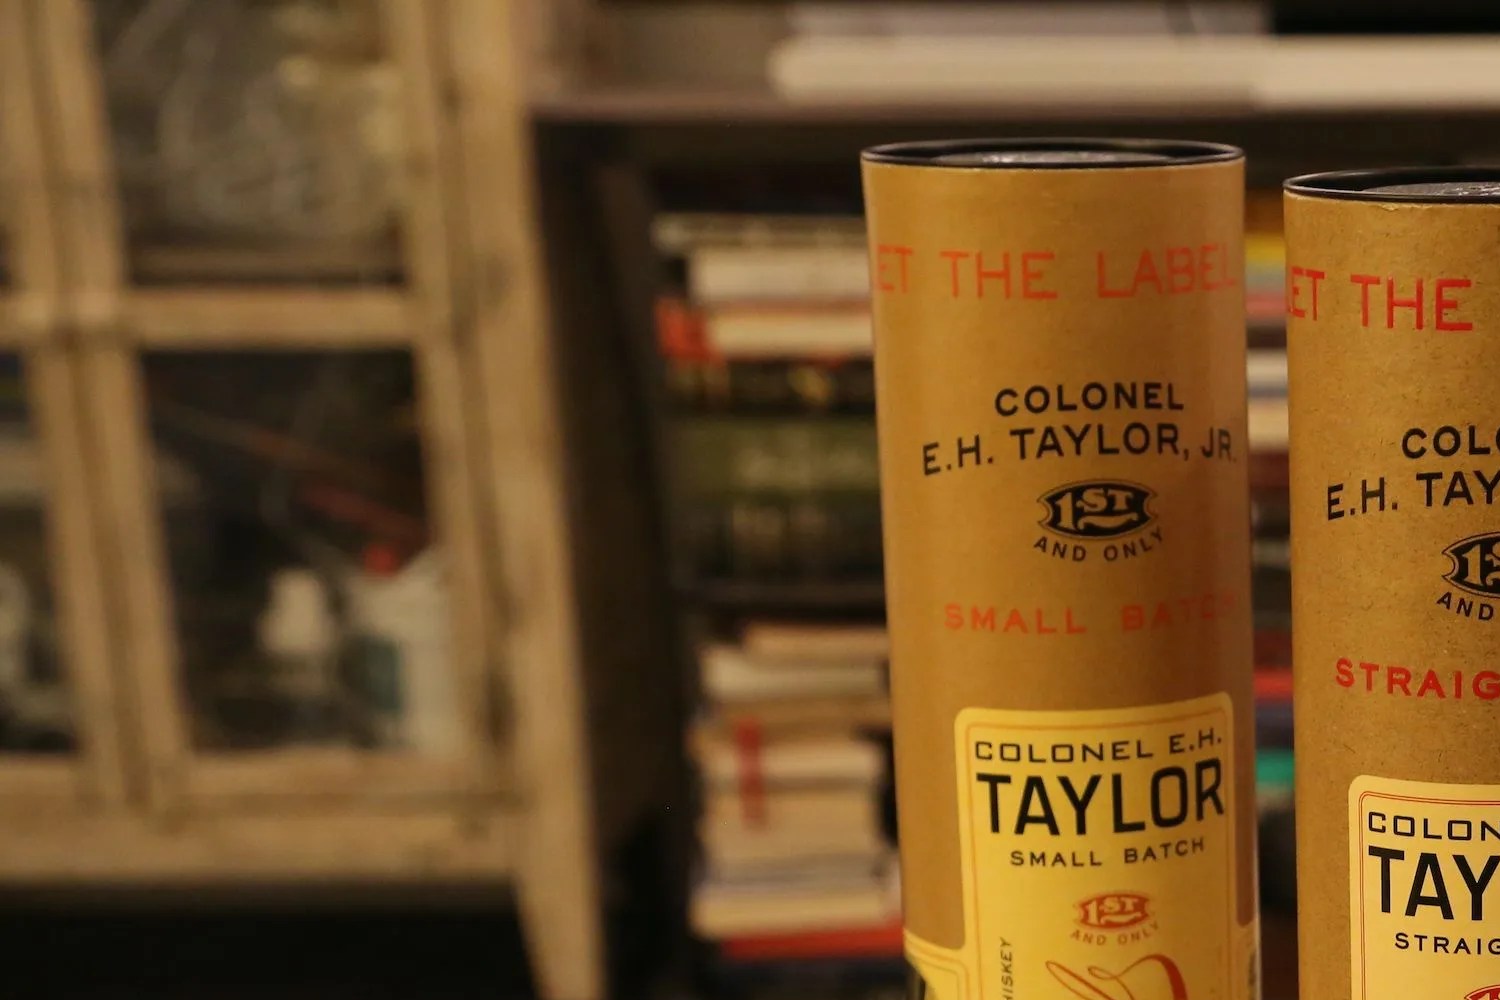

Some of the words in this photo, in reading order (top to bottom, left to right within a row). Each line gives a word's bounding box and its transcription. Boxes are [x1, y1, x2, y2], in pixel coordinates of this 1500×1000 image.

[940, 250, 1058, 300] THE
[1096, 243, 1238, 299] LABEL
[1350, 273, 1473, 331] THE
[995, 382, 1184, 417] COLONEL
[922, 434, 995, 476] E.H.
[1010, 422, 1190, 461] TAYLOR,
[1201, 426, 1238, 463] JR.
[1055, 485, 1140, 532] 1ST
[1327, 476, 1398, 520] E.H.
[1033, 535, 1087, 562] AND
[1103, 526, 1165, 562] ONLY
[944, 603, 1088, 635] SMALL
[1436, 590, 1494, 621] AND
[975, 739, 1153, 763] COLONEL
[1168, 728, 1223, 754] E.H.
[975, 756, 1225, 836] TAYLOR
[1010, 850, 1103, 868] SMALL
[1123, 837, 1205, 865] BATCH
[1070, 929, 1106, 947] AND
[1116, 922, 1160, 947] ONLY
